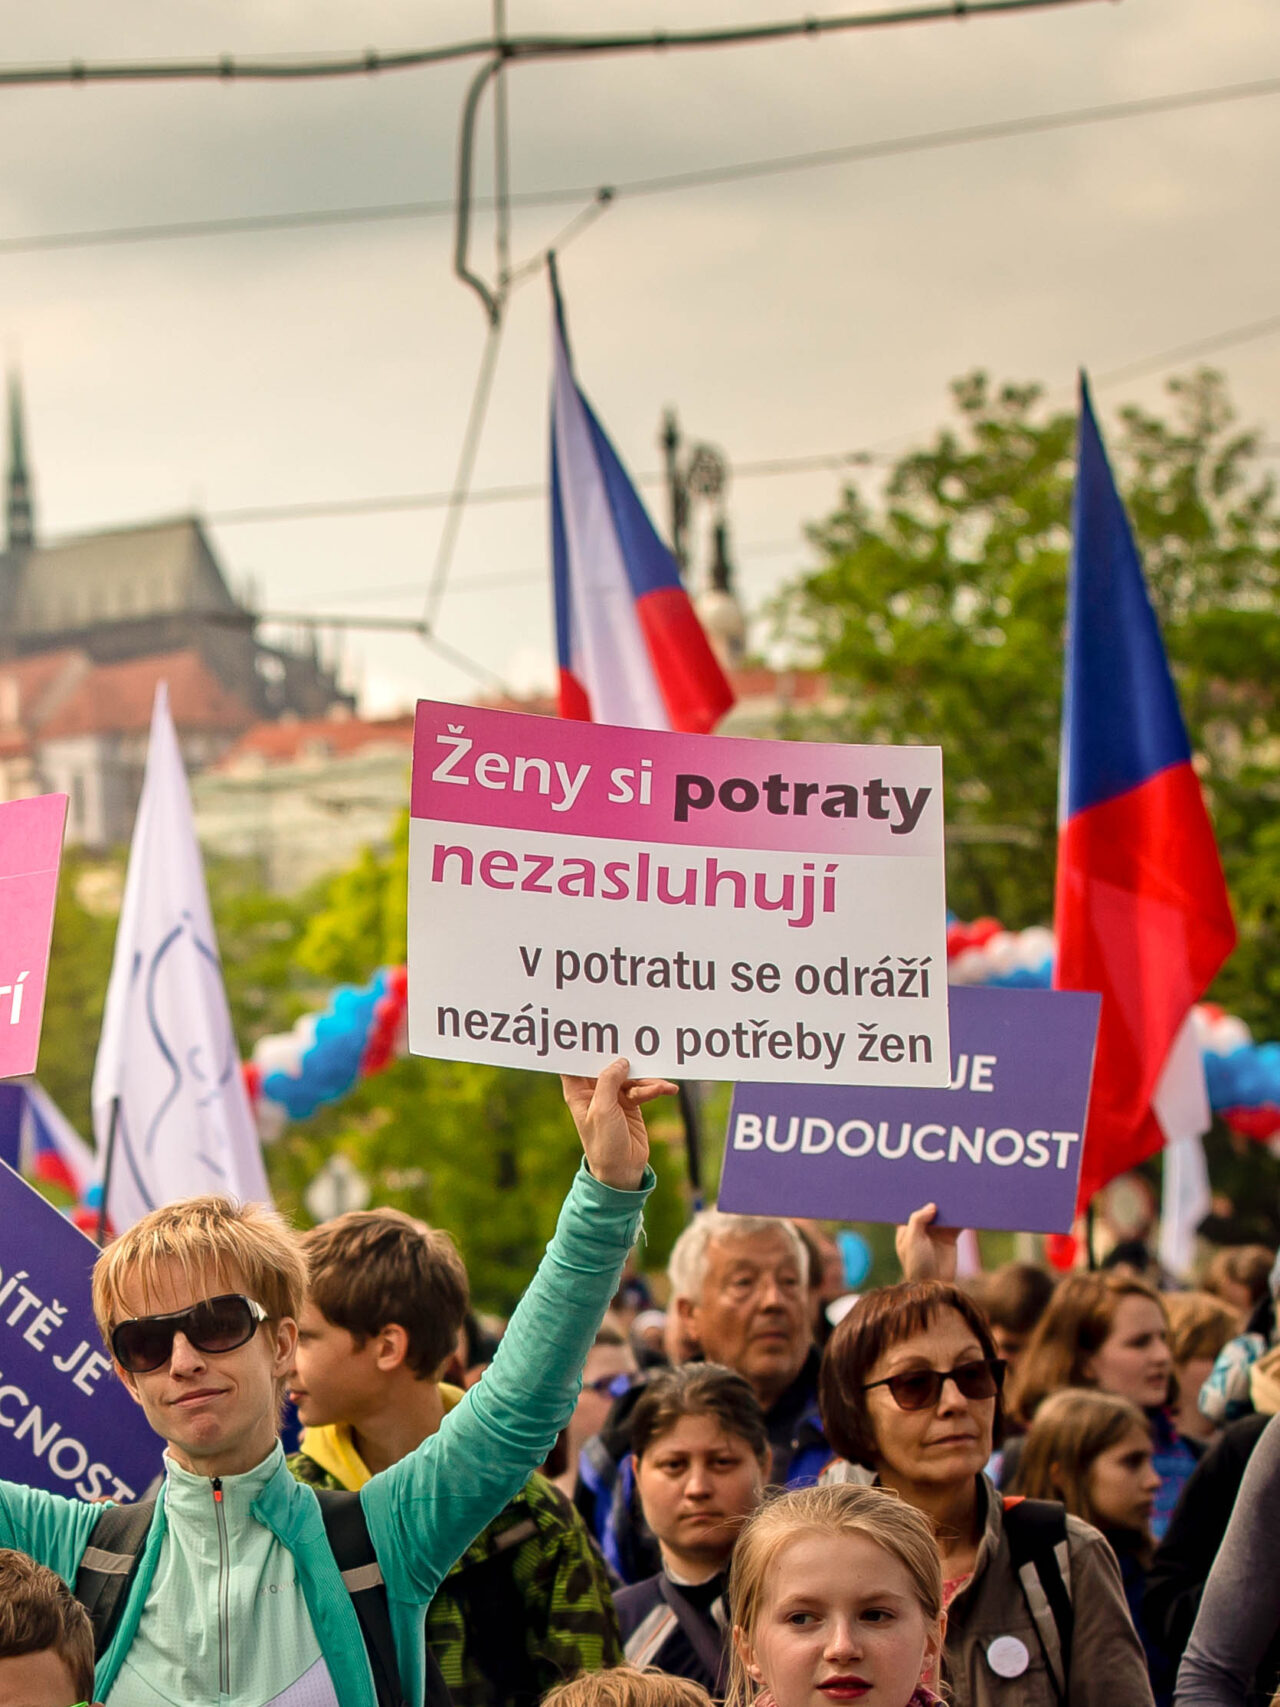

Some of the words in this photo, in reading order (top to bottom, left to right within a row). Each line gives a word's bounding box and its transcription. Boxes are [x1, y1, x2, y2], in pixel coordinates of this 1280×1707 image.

[431, 723, 591, 812] Ženy
[607, 758, 653, 806] si
[673, 773, 933, 835] potraty
[430, 844, 839, 928] nezasluhují
[519, 946, 542, 977] v
[555, 947, 716, 991] potratu
[730, 960, 781, 994] se
[794, 955, 933, 999] odráží
[437, 1002, 619, 1057] nezájem
[634, 1024, 660, 1056] o
[676, 1018, 846, 1071] potřeby
[857, 1021, 933, 1064] žen
[949, 1053, 998, 1093] JE
[732, 1113, 1080, 1170] BUDOUCNOST
[52, 1340, 113, 1397] JE
